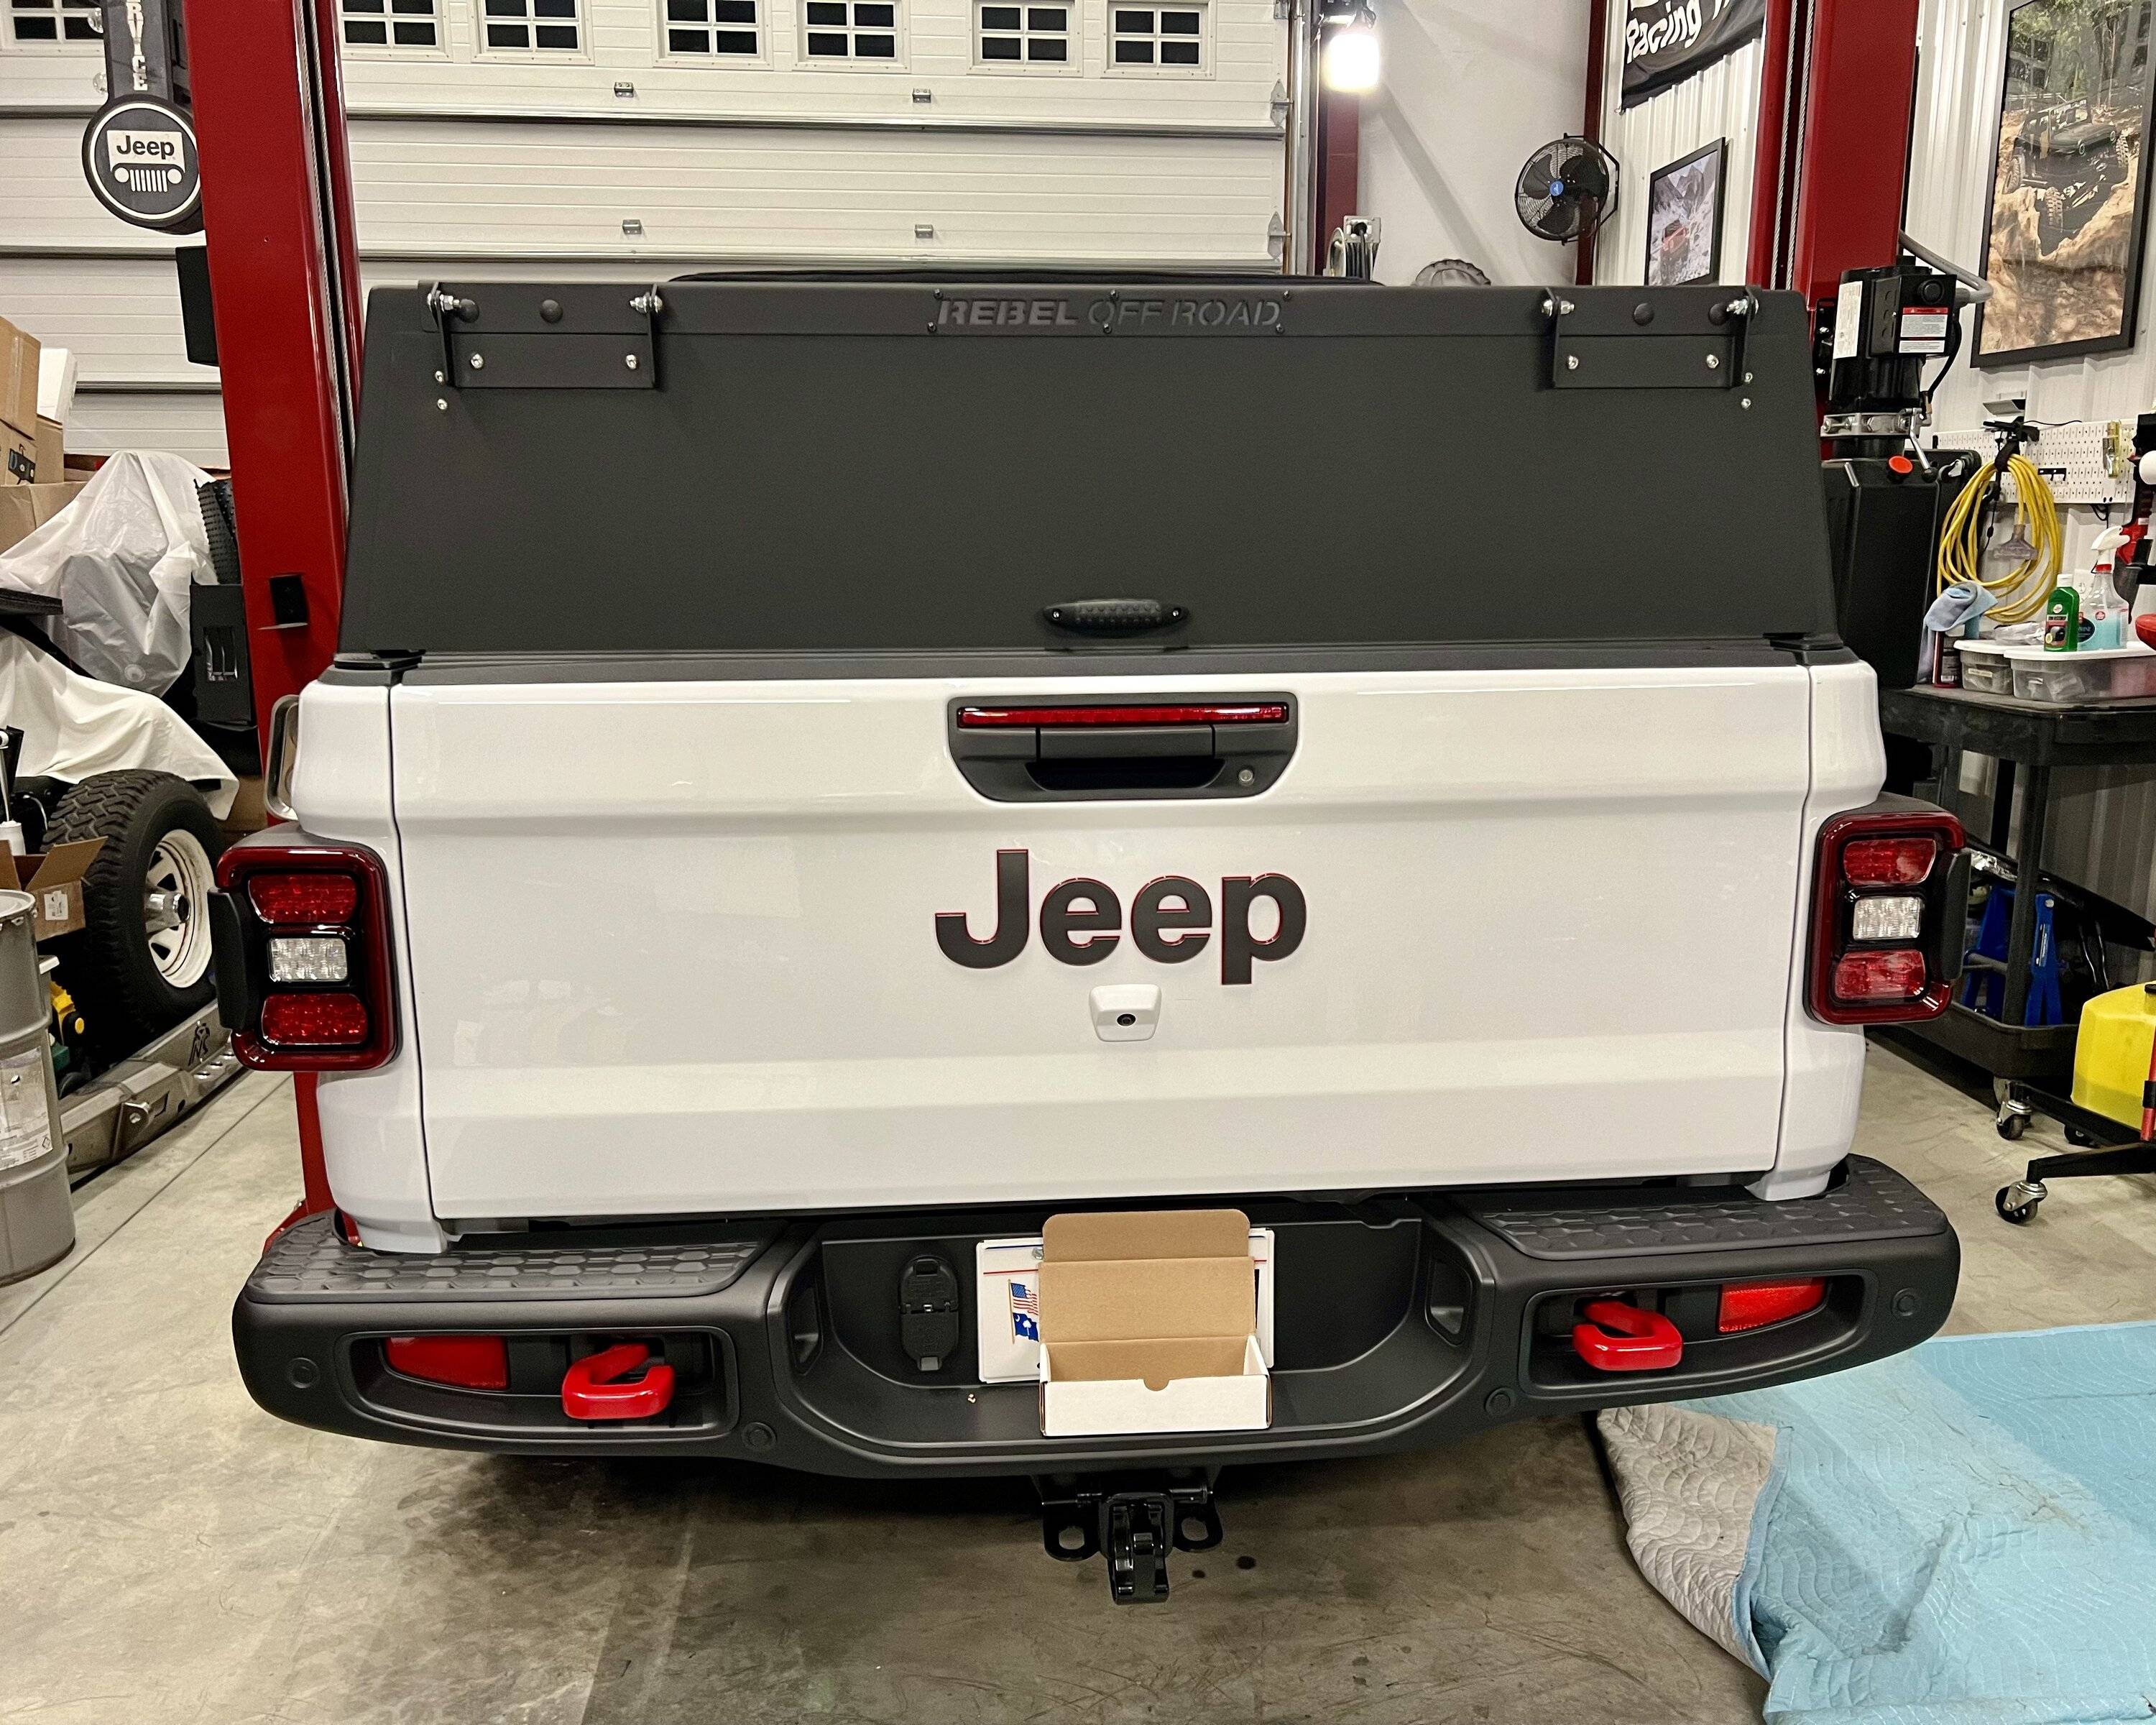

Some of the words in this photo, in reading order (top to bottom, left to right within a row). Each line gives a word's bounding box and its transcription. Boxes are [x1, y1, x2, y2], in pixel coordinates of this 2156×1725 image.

[126, 0, 148, 91] RVICE
[116, 135, 175, 160] Jeep
[937, 299, 1079, 326] REBEL
[1087, 299, 1166, 326] OFF
[1171, 299, 1282, 326] ROAD
[934, 849, 1307, 985] Jeep
